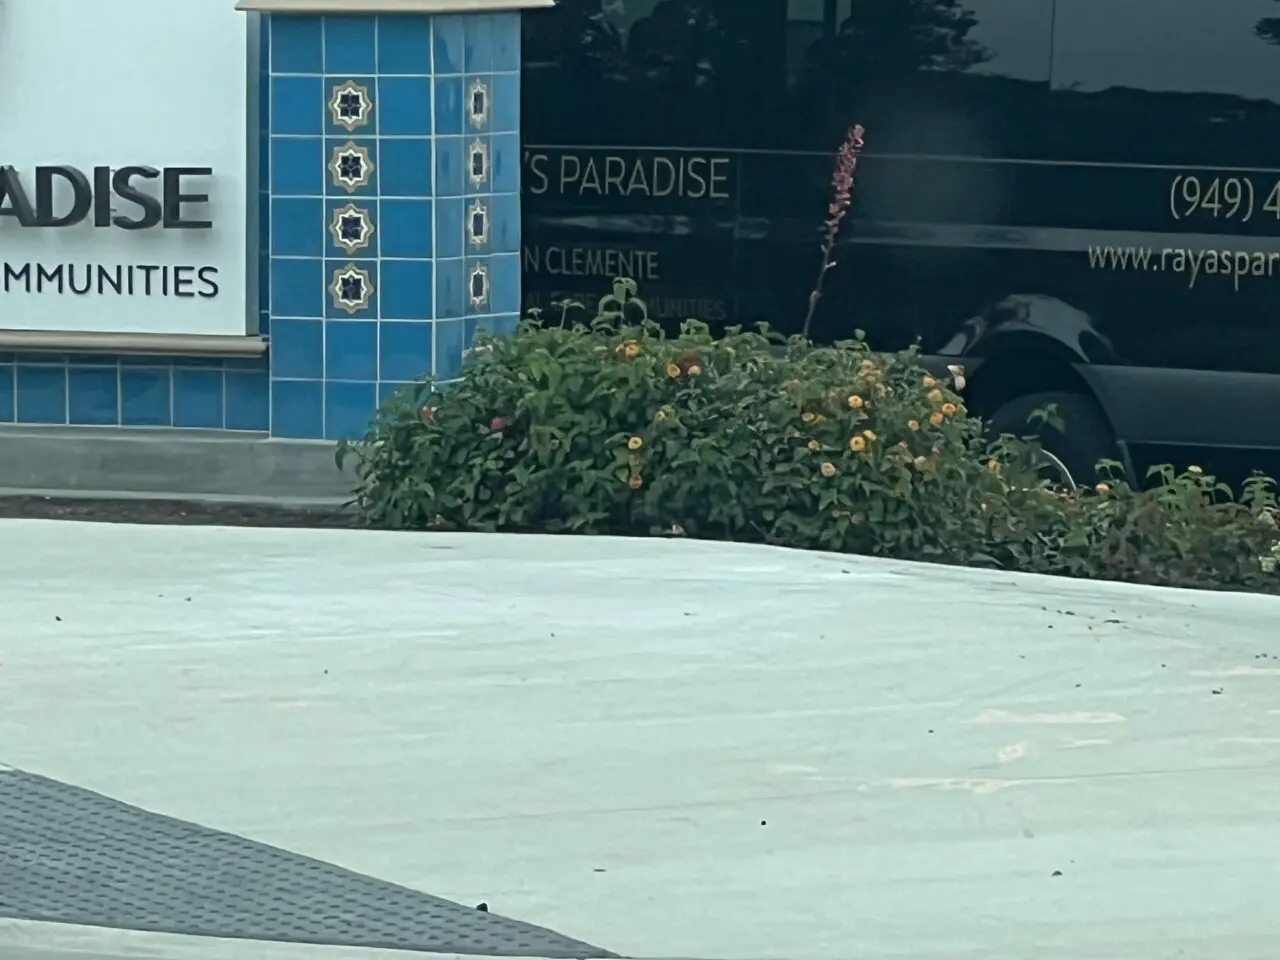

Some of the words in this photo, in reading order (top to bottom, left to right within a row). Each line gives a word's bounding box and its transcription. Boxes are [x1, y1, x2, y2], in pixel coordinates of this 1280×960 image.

[520, 151, 550, 195] 'S
[559, 155, 731, 199] PARADISE
[1170, 174, 1255, 223] (949)
[544, 247, 659, 279] CLEMENTE
[1087, 243, 1280, 292] www.rayaspar
